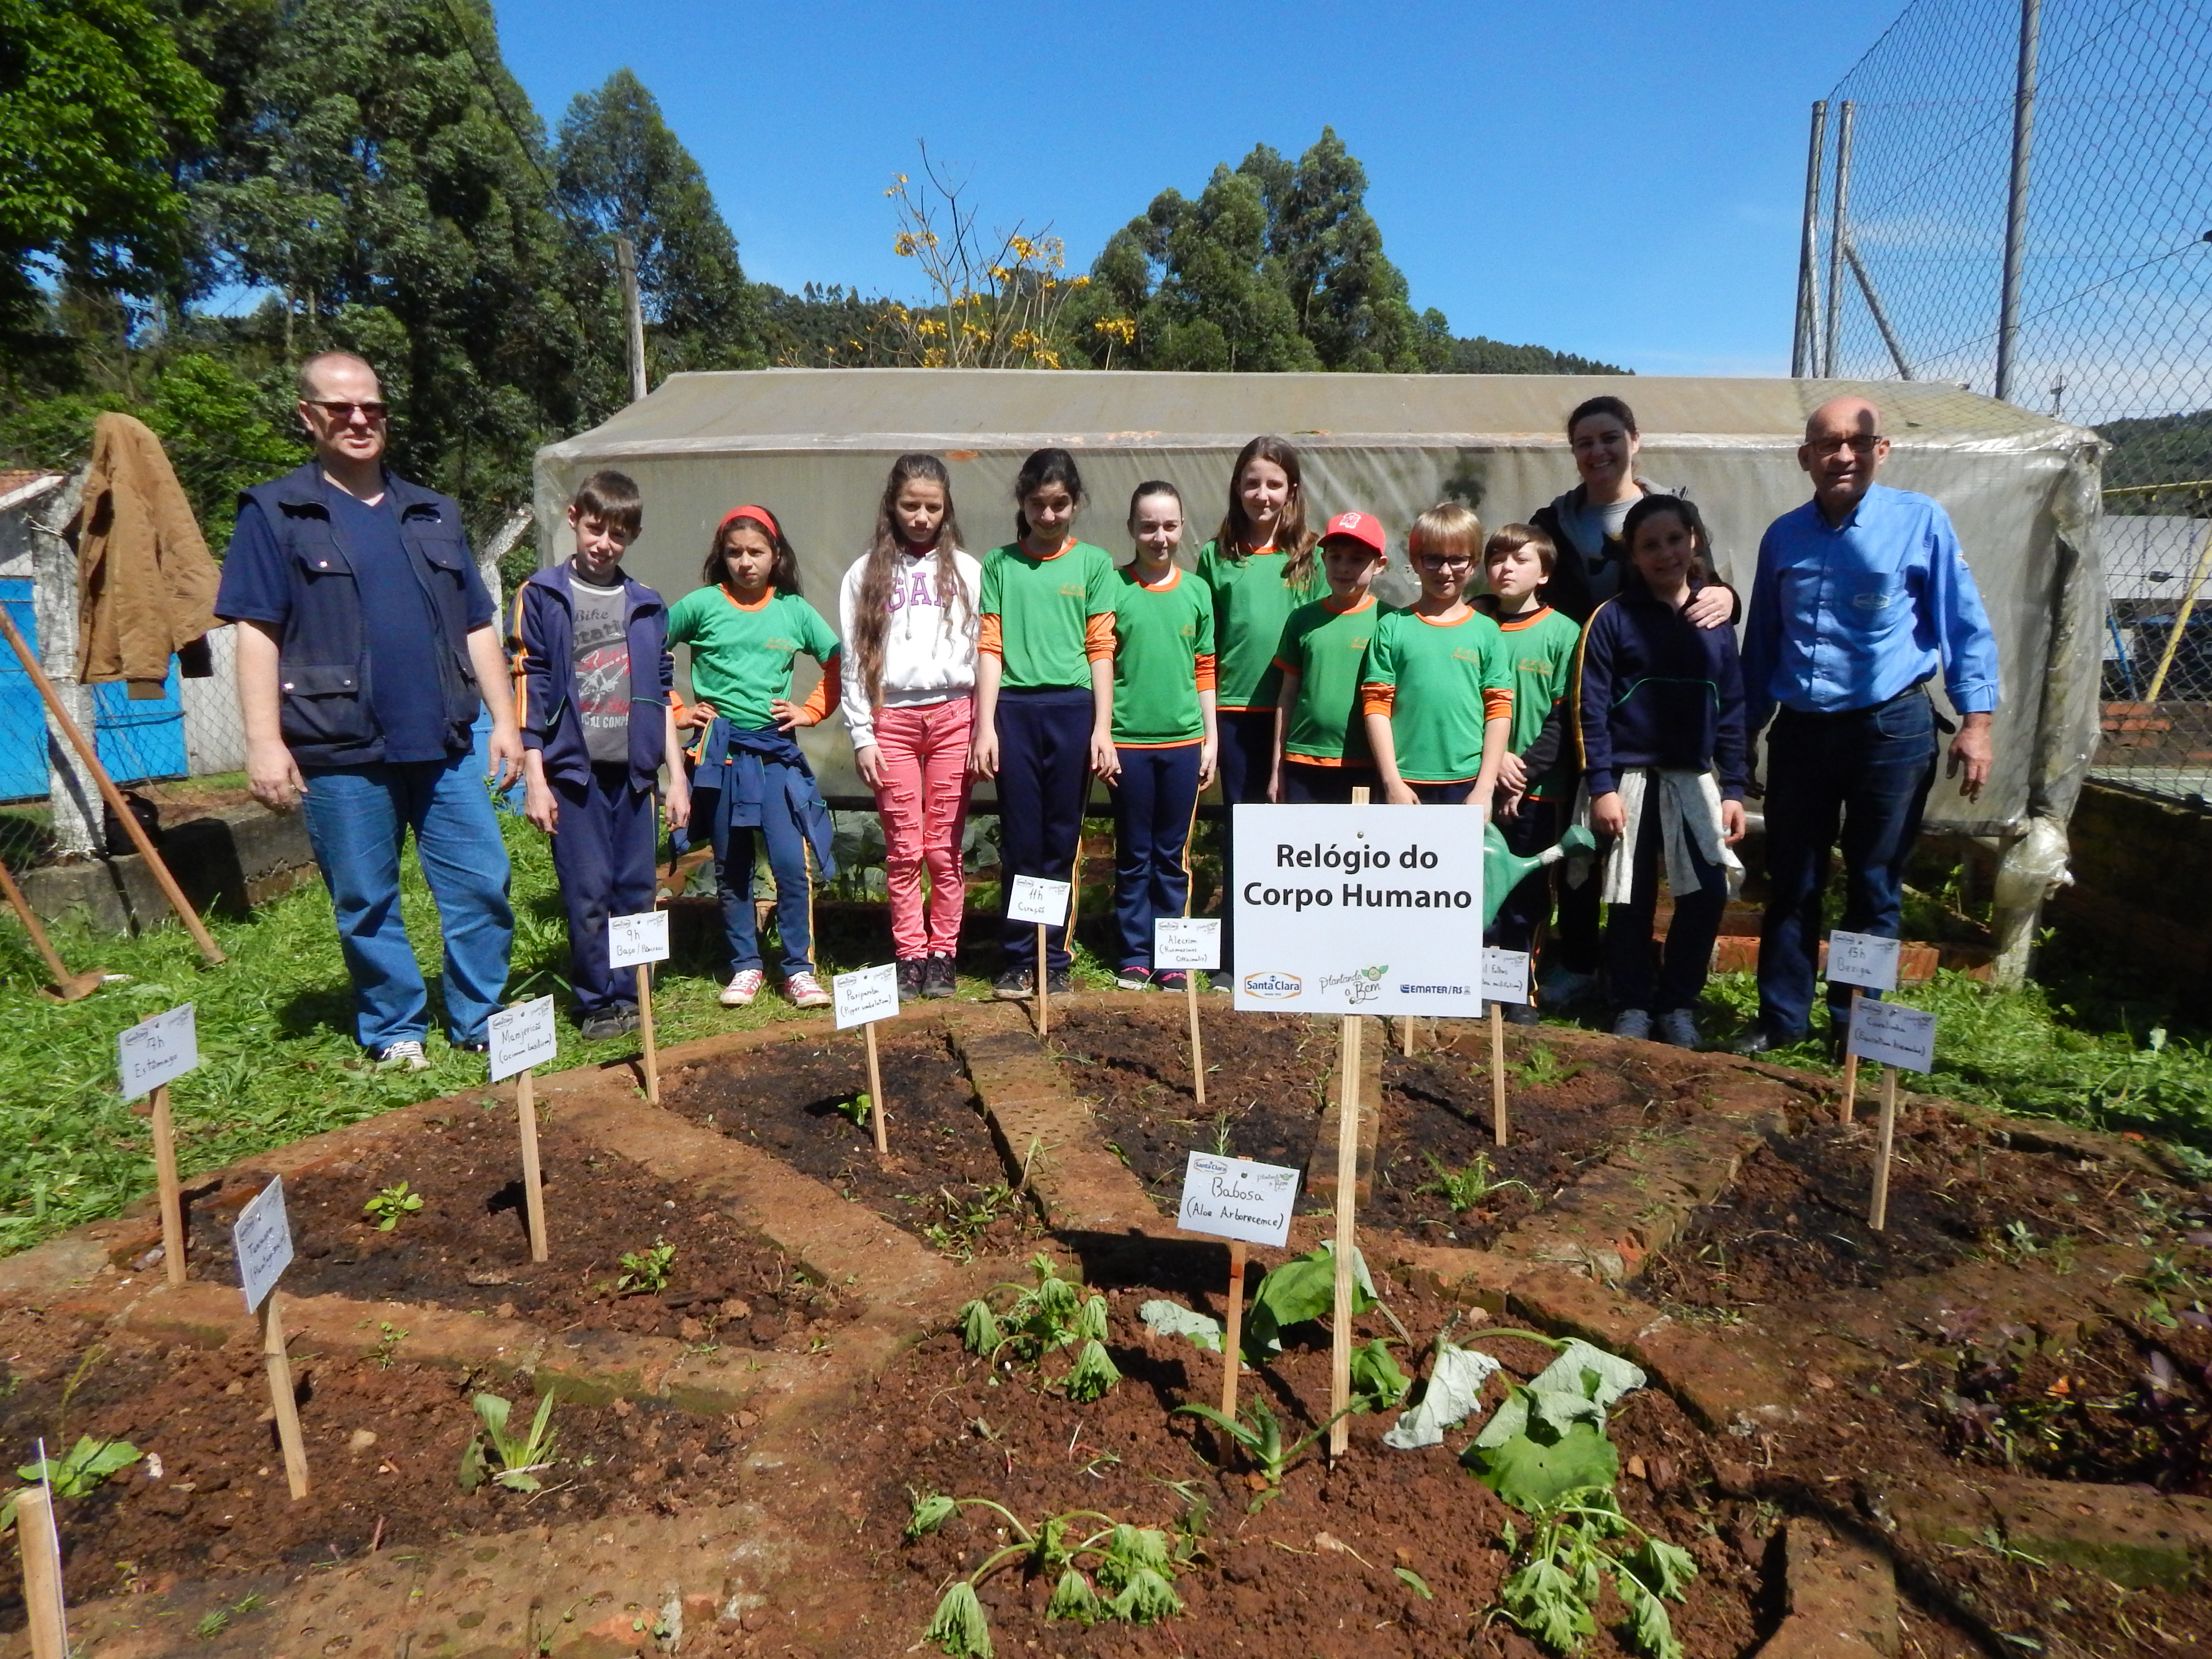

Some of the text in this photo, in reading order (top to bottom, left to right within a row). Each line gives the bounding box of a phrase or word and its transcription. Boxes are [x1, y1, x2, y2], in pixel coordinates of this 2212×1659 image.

[575, 608, 609, 622] Bike
[1277, 843, 1438, 874] Relógio do
[1244, 882, 1471, 912] Corpo Humano
[1018, 902, 1045, 914] Coração
[1168, 935, 1197, 944] Alecrim
[1247, 980, 1299, 990] Santa Clara
[1410, 985, 1463, 995] EMATER/RS
[1212, 1177, 1263, 1201] Babosa
[1187, 1196, 1212, 1218] (Aloe
